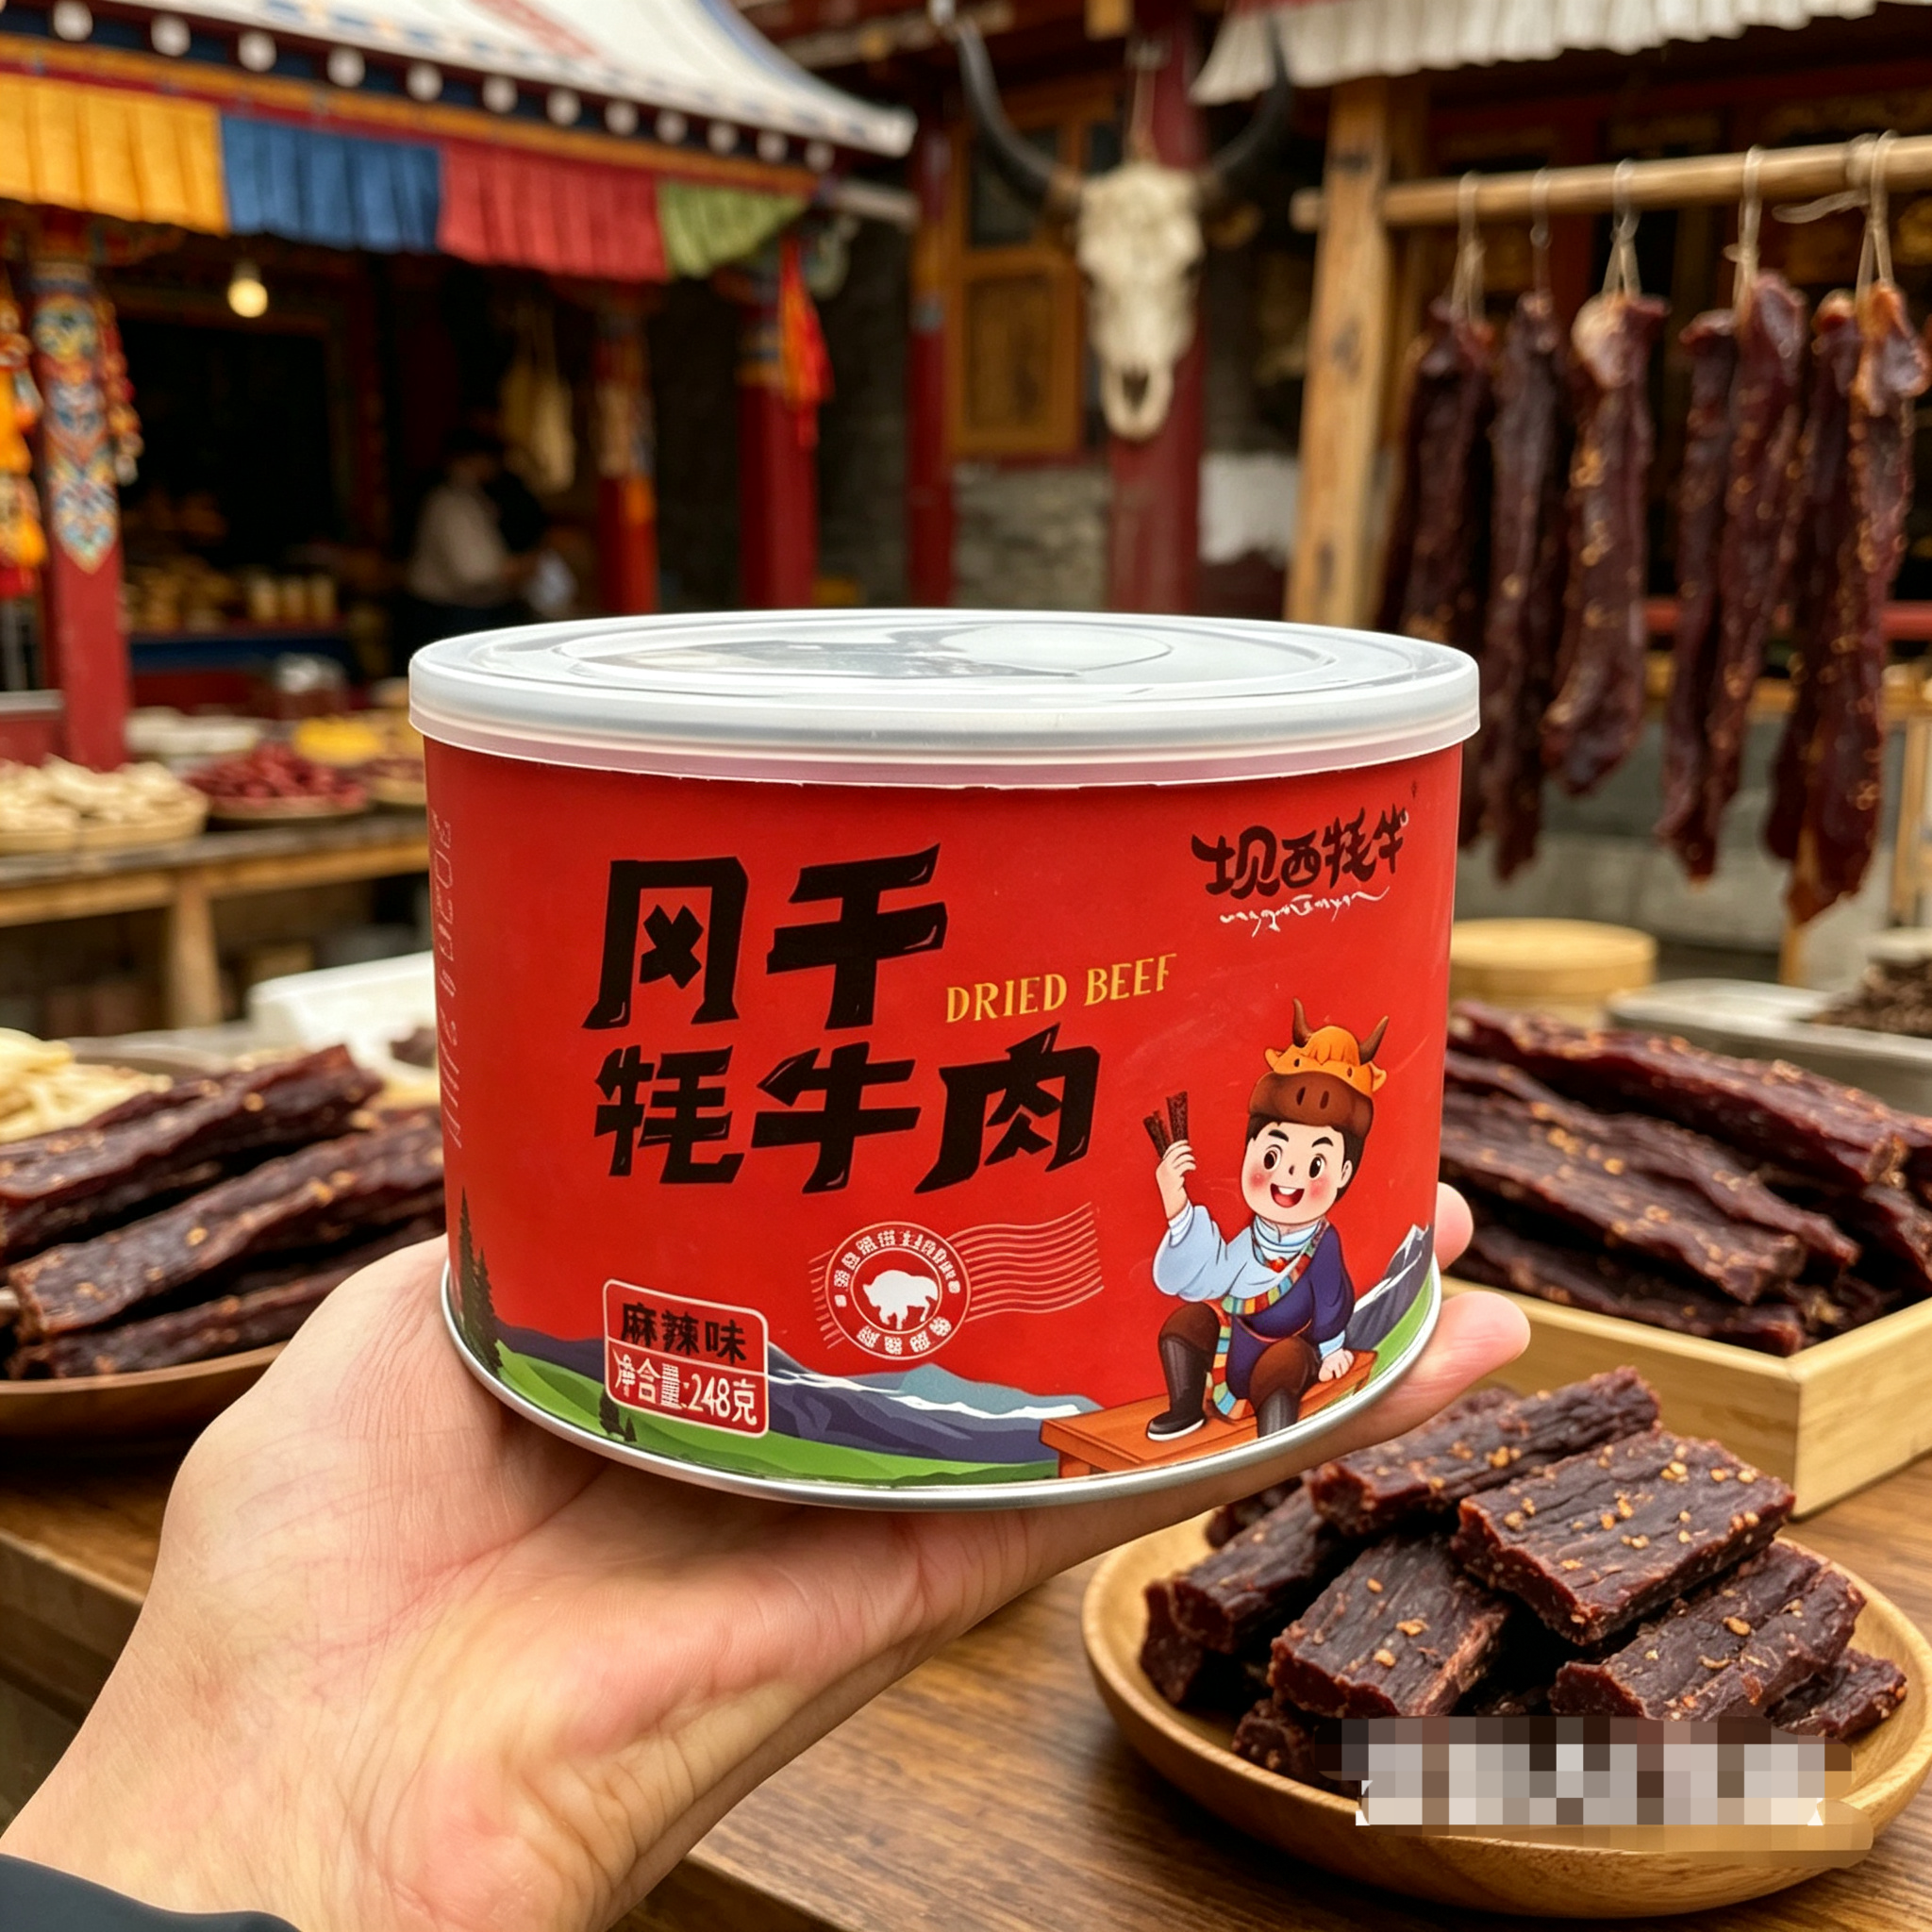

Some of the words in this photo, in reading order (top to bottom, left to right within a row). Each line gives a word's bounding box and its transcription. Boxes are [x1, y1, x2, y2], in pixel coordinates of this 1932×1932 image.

[946, 974, 1067, 1023] DRIED
[1084, 953, 1177, 1007] BEEF
[593, 1023, 1101, 1194] 牦牛肉
[620, 1302, 746, 1364] 麻辣味
